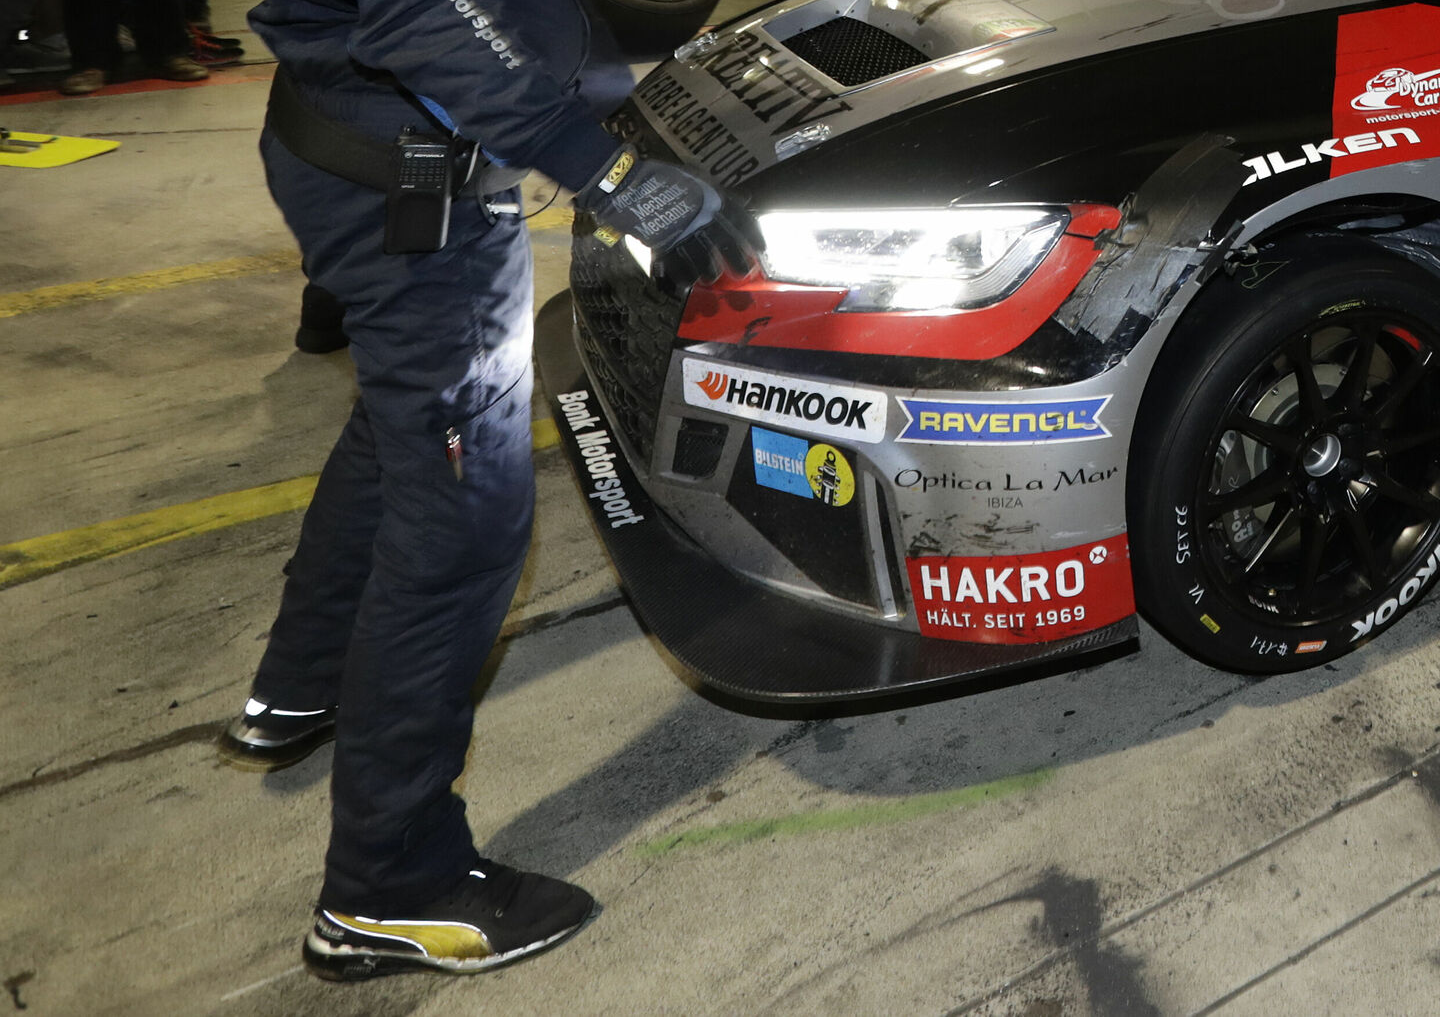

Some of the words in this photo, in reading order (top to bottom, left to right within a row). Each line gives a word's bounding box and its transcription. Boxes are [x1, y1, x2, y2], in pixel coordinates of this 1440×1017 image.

[612, 177, 661, 213] Mechanix
[630, 183, 685, 221] Mechanix
[635, 200, 692, 239] Mechanix
[557, 390, 601, 432] Bonk
[919, 410, 1089, 435] RAVENOL
[755, 448, 804, 476] BILSTEIN
[894, 468, 992, 492] Optica
[1003, 473, 1044, 491] La
[1053, 466, 1119, 492] Mar
[575, 430, 645, 529] Motorsport
[987, 496, 1024, 509] IBIZA
[1176, 531, 1191, 564] SET
[920, 559, 1086, 604] HAKRO
[926, 608, 978, 629] HÄLT.
[983, 613, 1026, 629] SEIT
[1035, 605, 1086, 627] 1969
